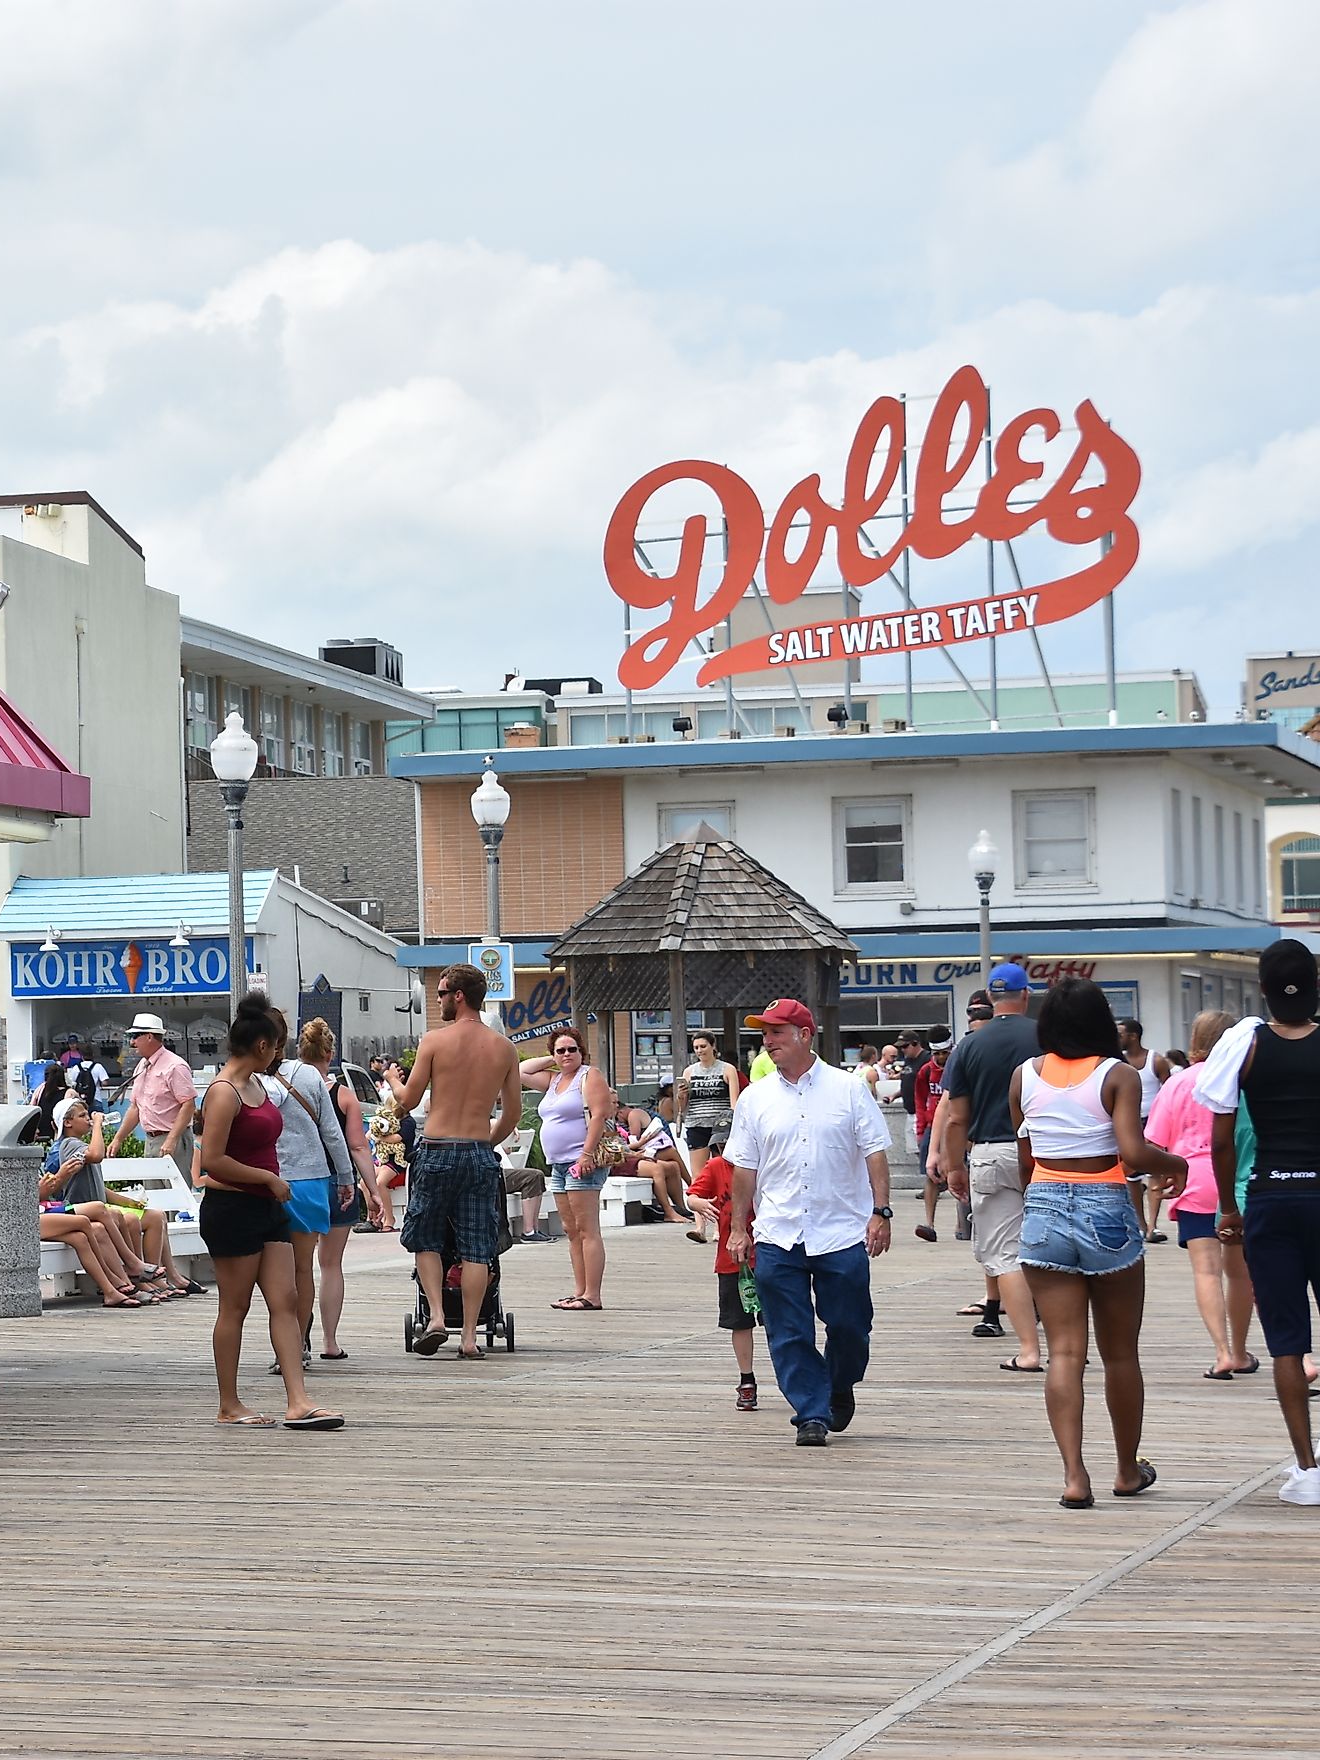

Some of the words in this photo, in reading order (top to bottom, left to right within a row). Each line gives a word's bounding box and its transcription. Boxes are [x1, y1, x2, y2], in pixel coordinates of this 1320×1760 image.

[603, 364, 1142, 690] Dolles
[768, 626, 835, 665] SALT
[840, 609, 944, 656] WATER
[946, 594, 1040, 639] TAFFY
[13, 950, 119, 989] KOHR
[145, 946, 249, 986] BRO
[95, 986, 123, 994] Frozen
[142, 985, 174, 993] Custard
[511, 1031, 531, 1043] SALT
[533, 1020, 564, 1036] WATER
[14, 1065, 21, 1076] 5
[694, 1080, 720, 1088] EVERY
[695, 1089, 721, 1097] THING
[1269, 1170, 1317, 1181] Supeme
